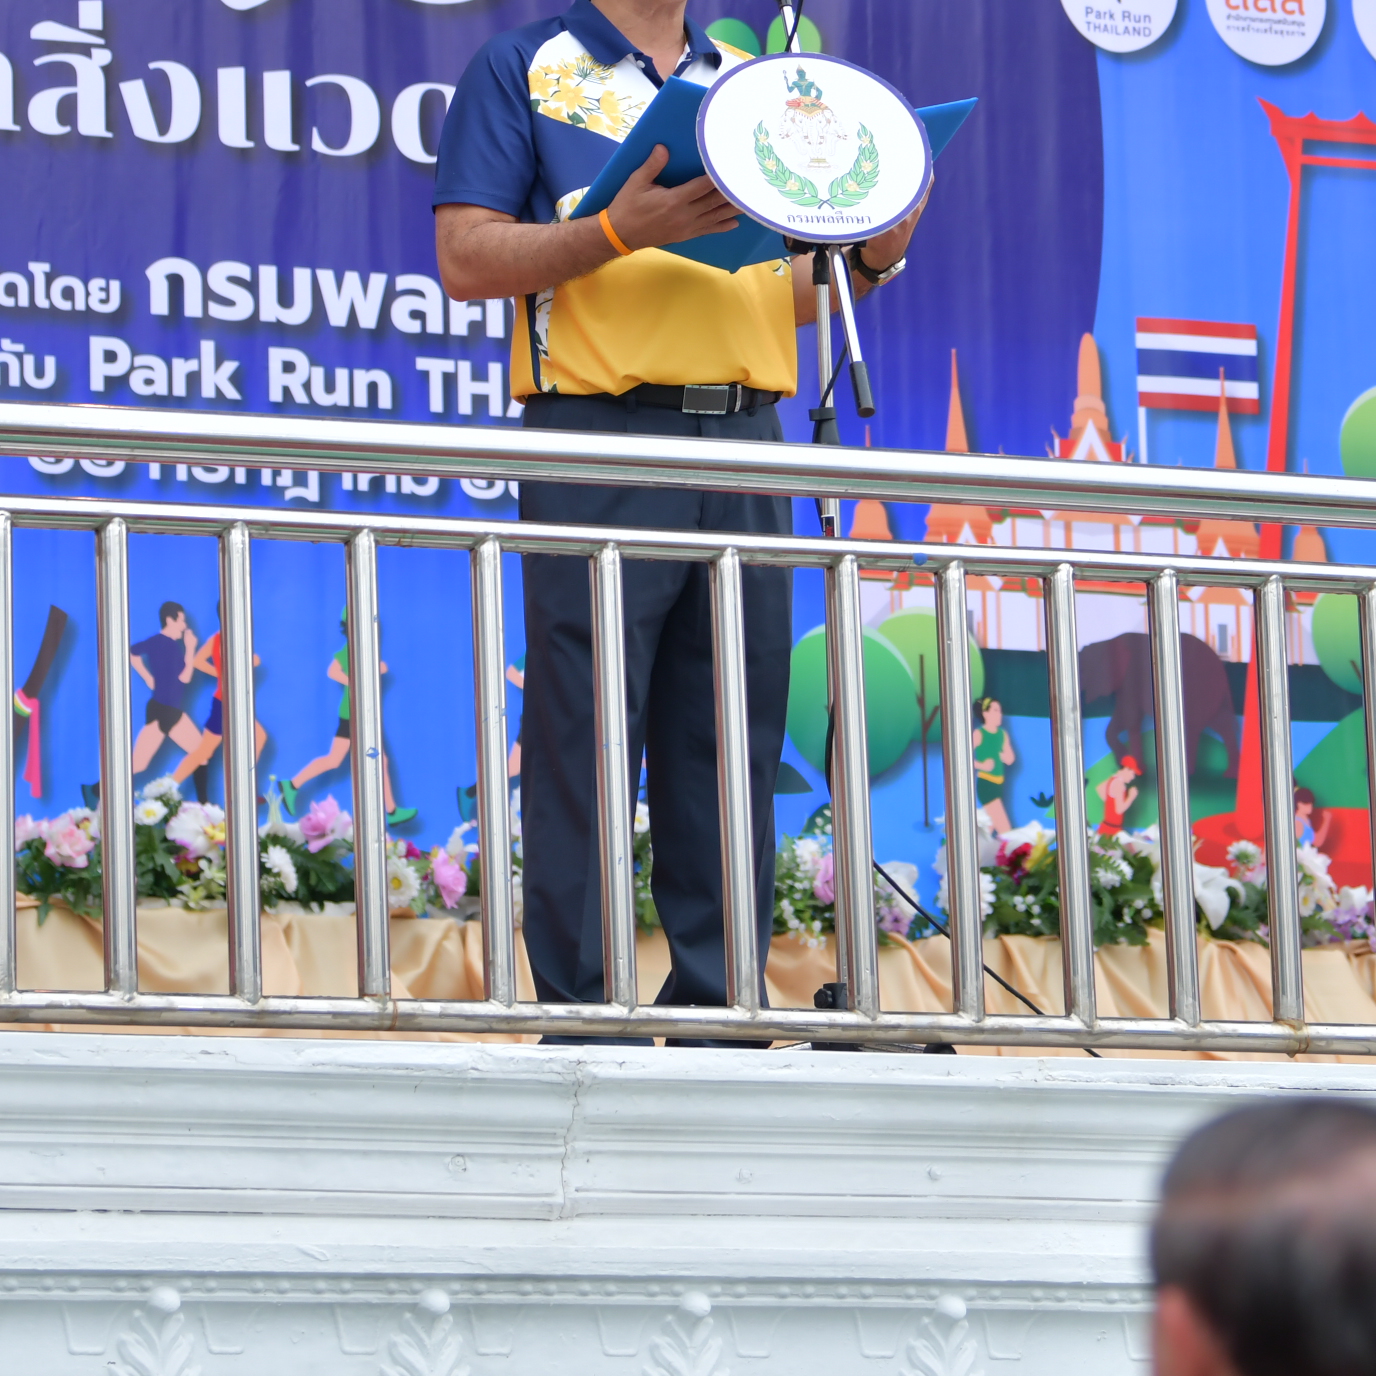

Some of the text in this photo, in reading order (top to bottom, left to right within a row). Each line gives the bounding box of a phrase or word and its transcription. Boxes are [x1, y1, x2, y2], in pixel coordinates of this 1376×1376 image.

[1085, 6, 1152, 24] Park Run
[1085, 21, 1152, 37] THAILAND
[787, 211, 872, 225] กรมพลศึกษา
[89, 335, 242, 401] Park
[267, 346, 393, 410] Run
[415, 356, 525, 419] TH
